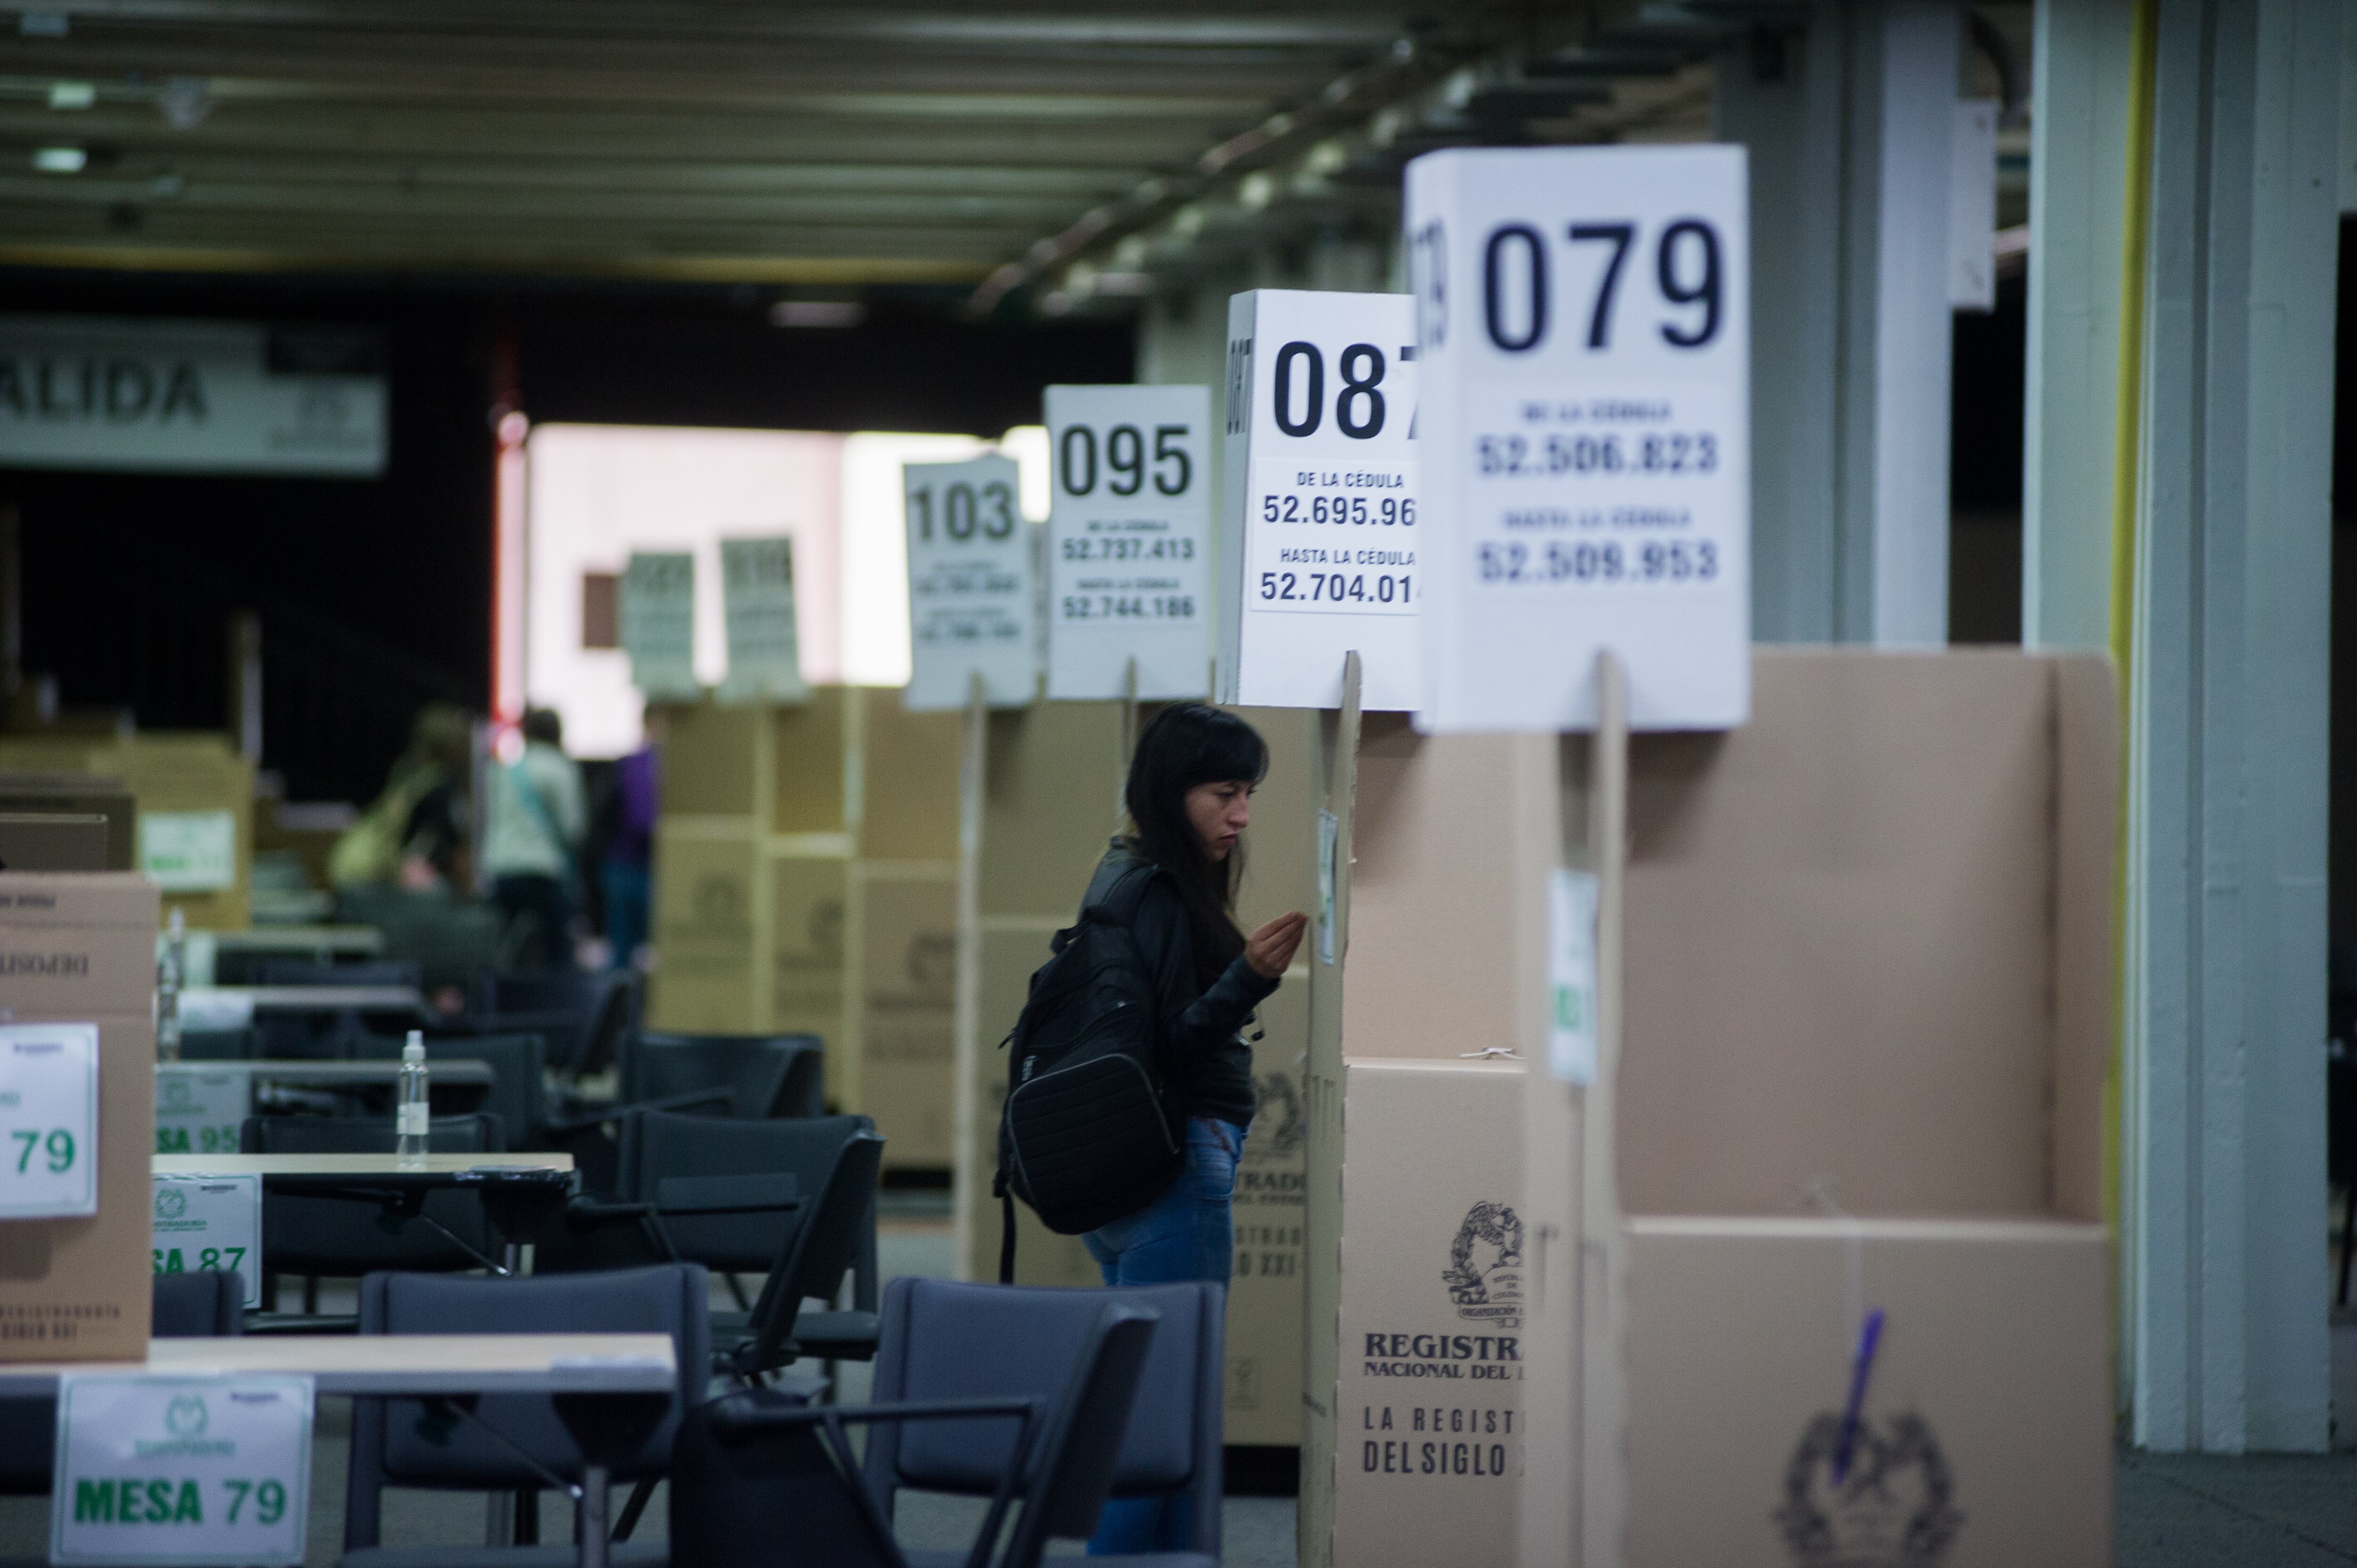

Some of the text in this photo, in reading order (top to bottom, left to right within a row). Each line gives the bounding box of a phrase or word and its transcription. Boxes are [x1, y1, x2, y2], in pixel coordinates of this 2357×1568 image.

[1482, 214, 1726, 353] 079
[1059, 424, 1193, 497] 095
[1297, 470, 1404, 489] DE LA CÉDULA
[907, 479, 1016, 543] 103
[1062, 536, 1195, 561] 52.737.413
[1280, 546, 1416, 566] HASTA LA CÉDULA
[1261, 572, 1421, 604] 52.704.01
[10, 1129, 76, 1174] 79
[199, 1247, 247, 1272] 87
[1364, 1333, 1522, 1362] REGISTR
[1363, 1361, 1464, 1378] NACIONAL
[1470, 1365, 1510, 1380] DEL
[1363, 1406, 1394, 1431] LA
[1363, 1440, 1506, 1477] DEL SIGLO
[73, 1476, 287, 1526] MESA 79
